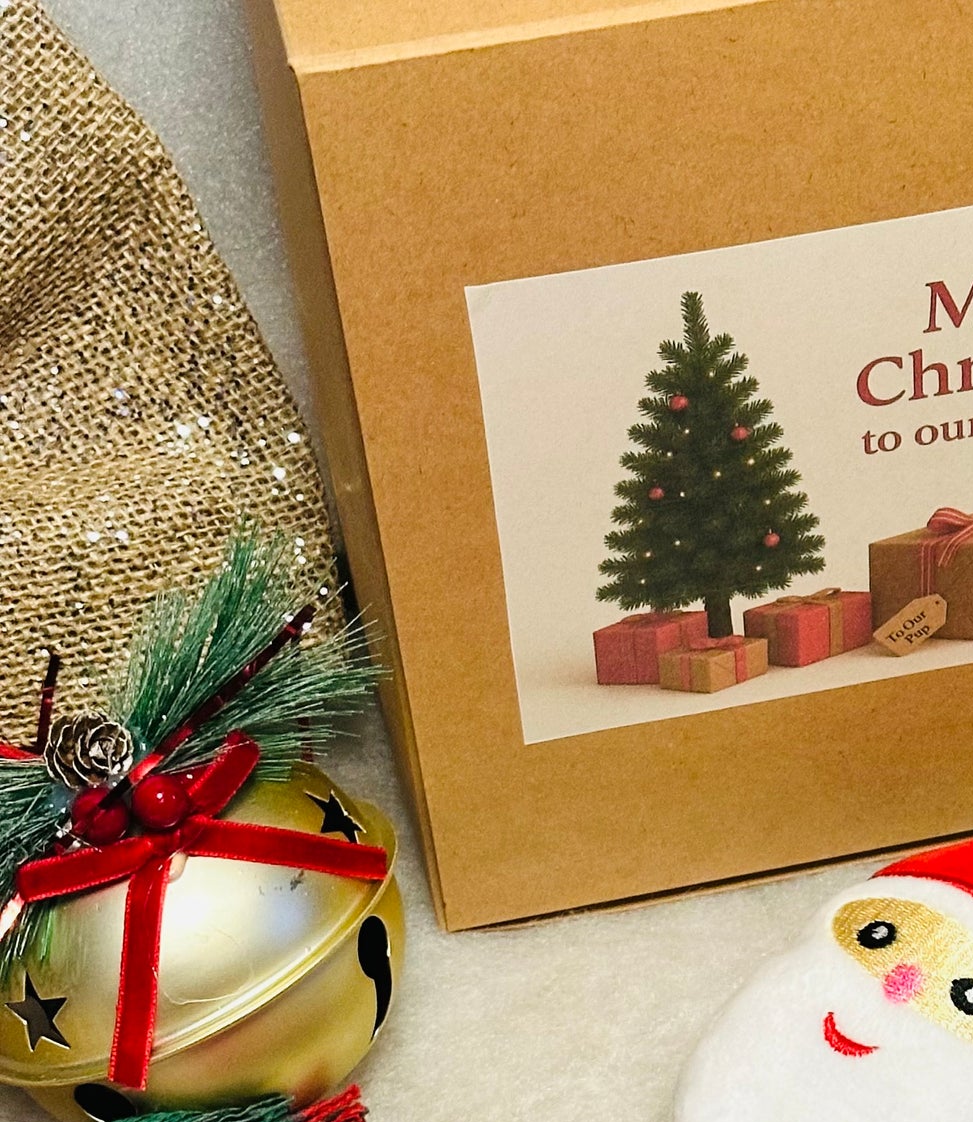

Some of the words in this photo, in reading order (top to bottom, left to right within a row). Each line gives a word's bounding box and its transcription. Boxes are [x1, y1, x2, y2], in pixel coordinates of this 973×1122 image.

[861, 429, 903, 455] to
[886, 629, 905, 643] To
[902, 610, 927, 631] Our
[904, 625, 931, 644] Pup
